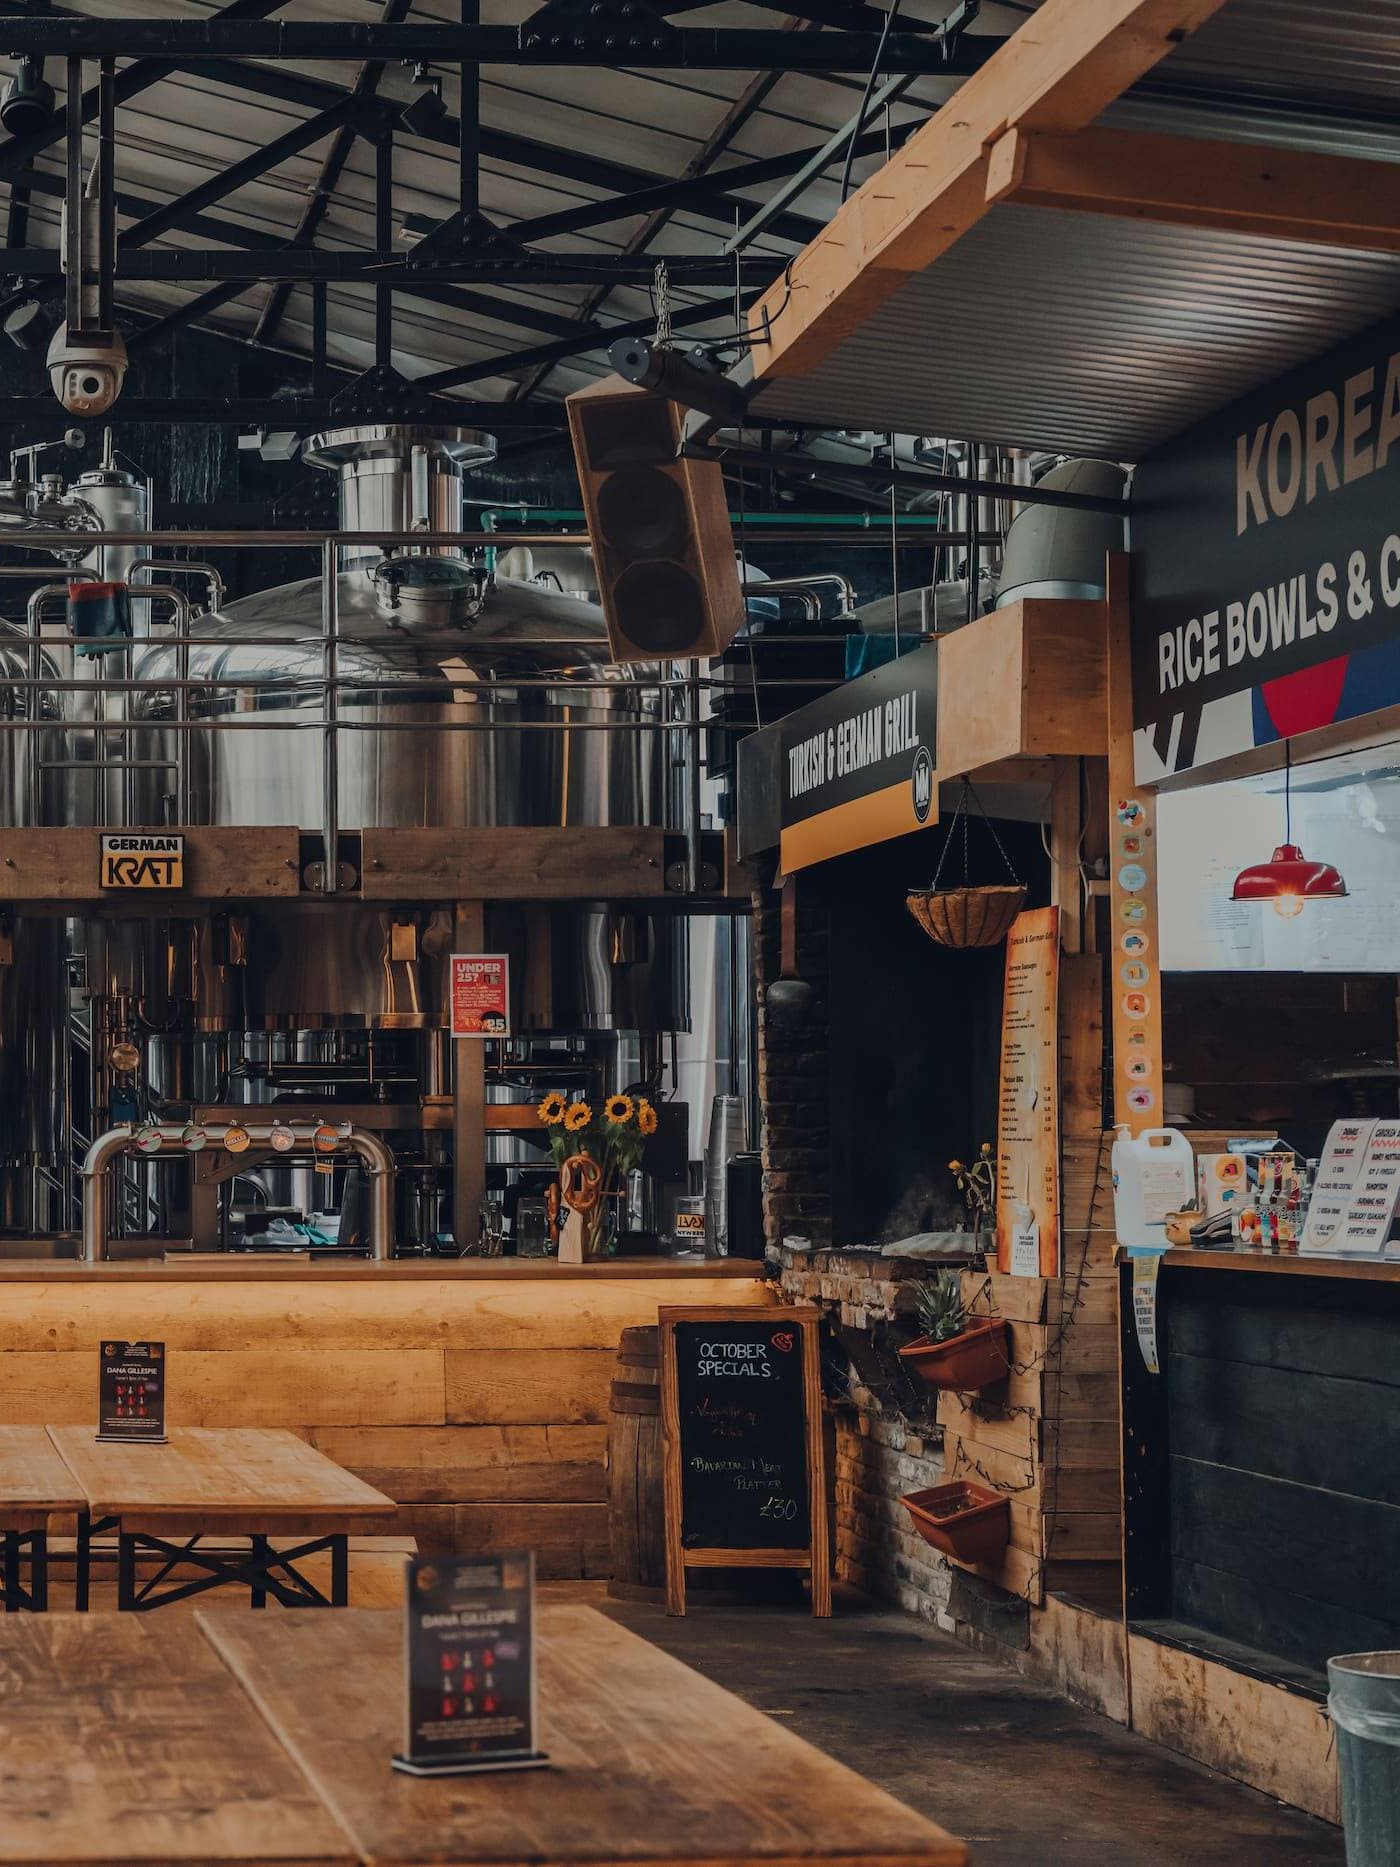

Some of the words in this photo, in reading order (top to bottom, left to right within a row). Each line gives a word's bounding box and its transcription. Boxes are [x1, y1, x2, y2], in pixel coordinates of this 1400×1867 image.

[1158, 611, 1221, 695] RICE
[1226, 561, 1340, 667] BOWLS
[1347, 550, 1375, 620] &
[789, 732, 825, 800] TURKISH
[827, 727, 835, 781] &
[837, 705, 882, 778] GERMAN
[885, 690, 920, 758] GRILL
[915, 766, 929, 803] MM
[108, 839, 178, 852] GERMAN
[107, 857, 179, 886] KRAFT
[456, 962, 502, 973] UNDER
[457, 973, 479, 983] 25?
[677, 1216, 705, 1229] KRAFT
[700, 1343, 767, 1359] OCTOBER
[107, 1367, 127, 1375] DANA
[127, 1367, 158, 1376] GILLESPIE
[698, 1360, 772, 1378] SPECIALS
[759, 1496, 798, 1521] £30
